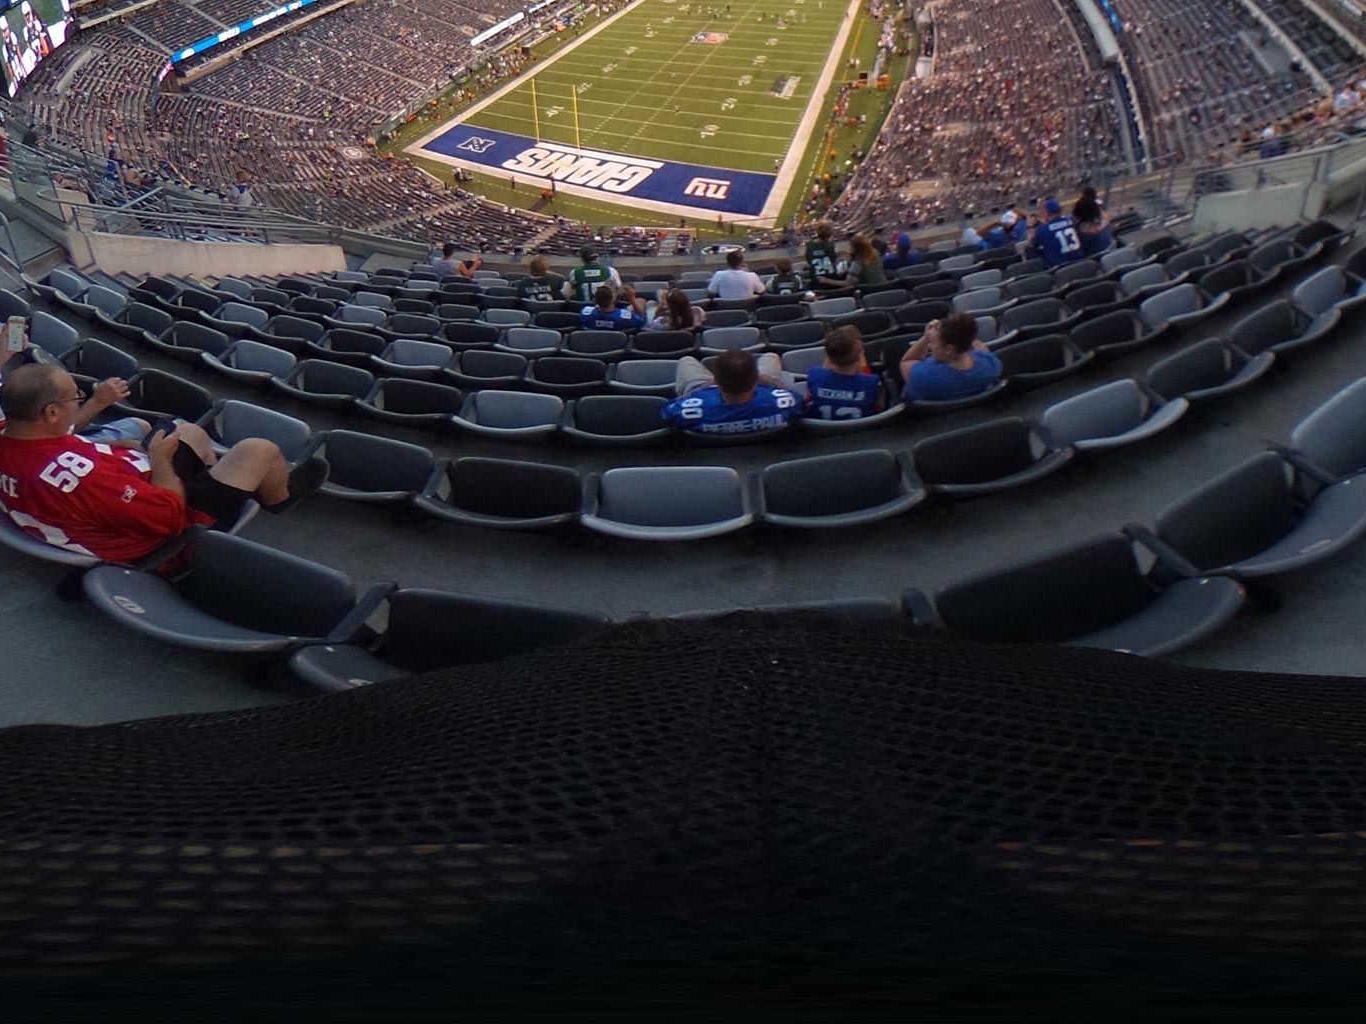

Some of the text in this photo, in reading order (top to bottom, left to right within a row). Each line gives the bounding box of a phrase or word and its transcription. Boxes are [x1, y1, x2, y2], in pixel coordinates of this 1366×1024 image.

[502, 147, 654, 193] GIANTS
[1055, 227, 1081, 254] 13
[39, 451, 95, 493] 58
